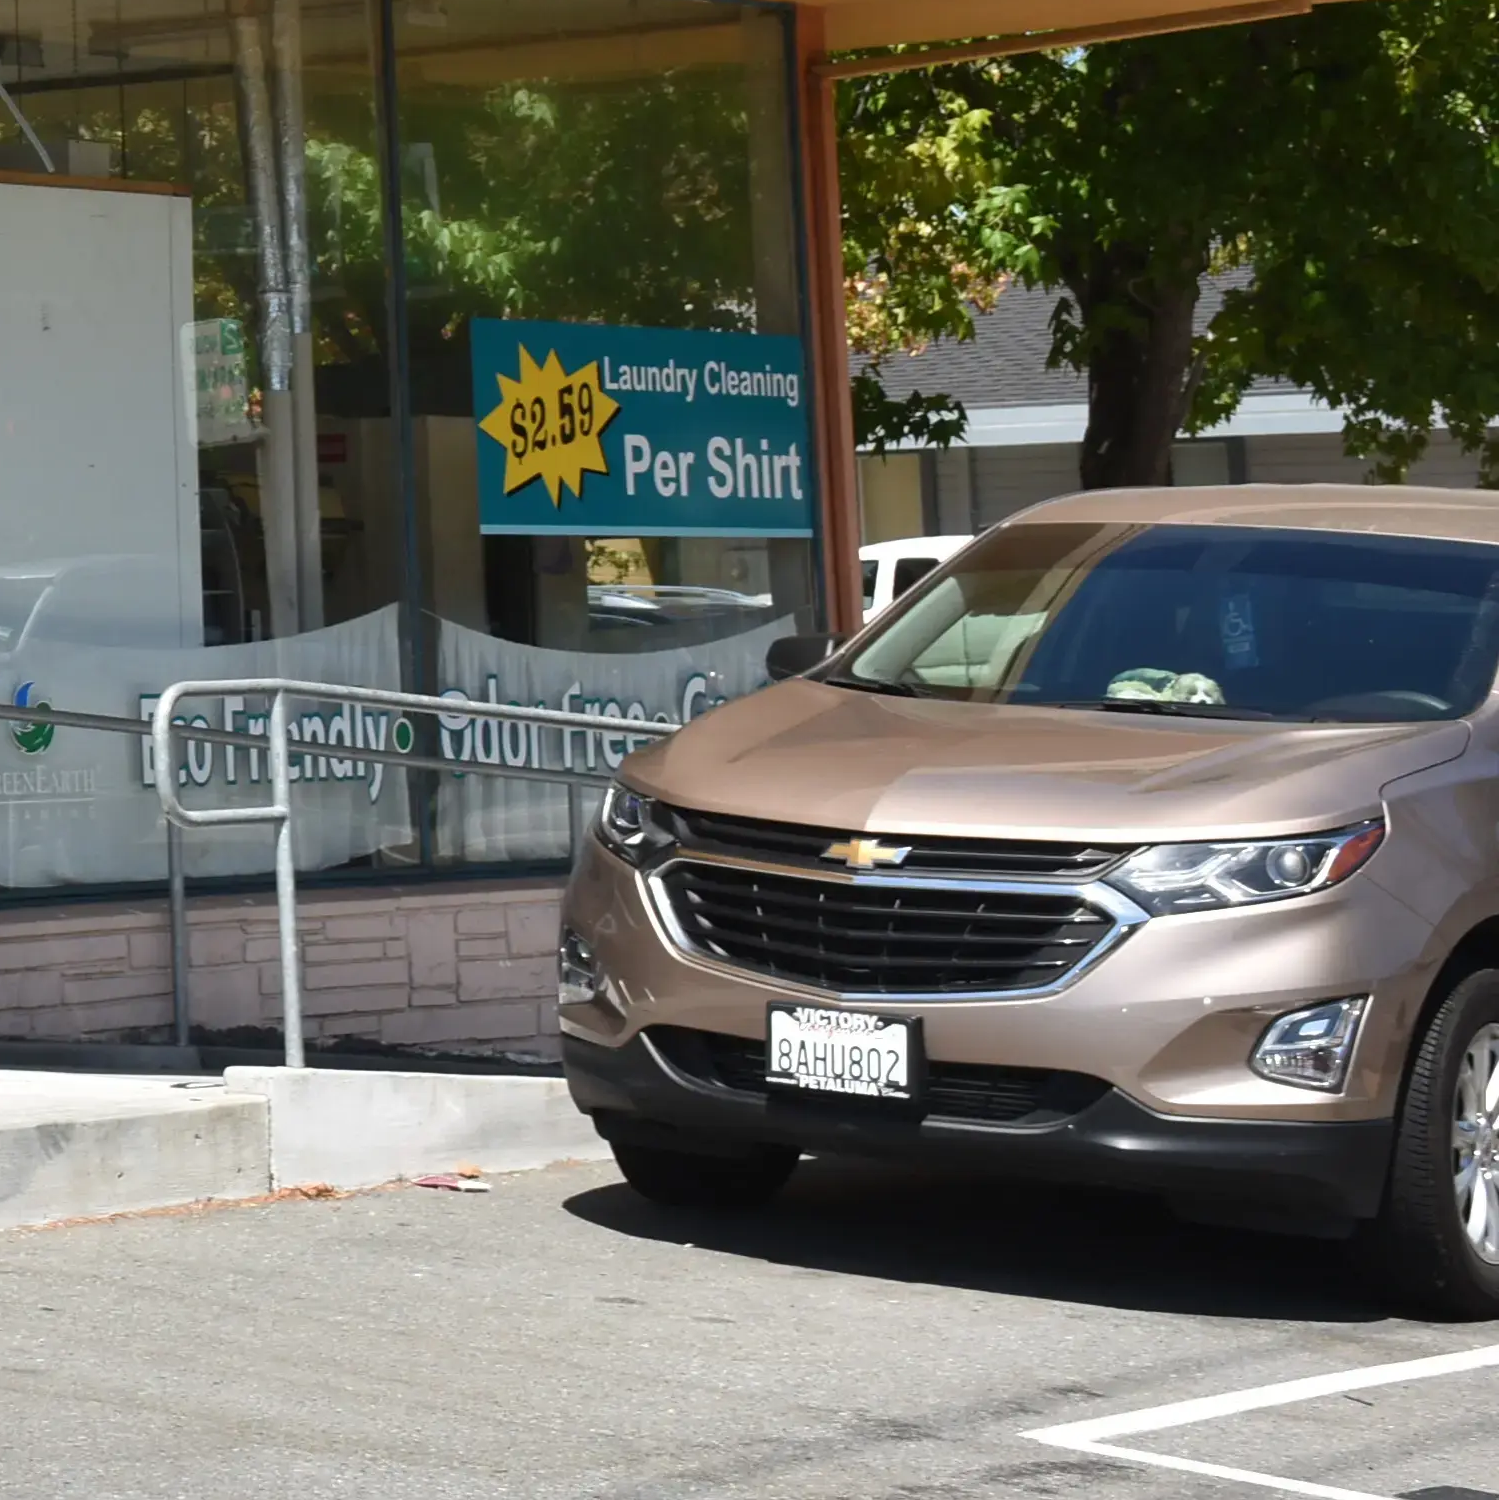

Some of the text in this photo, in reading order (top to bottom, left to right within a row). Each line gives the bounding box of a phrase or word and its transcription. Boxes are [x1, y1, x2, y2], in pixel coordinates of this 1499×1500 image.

[603, 356, 799, 407] Laundry Cleaning
[510, 381, 594, 465] $2.59
[623, 434, 803, 500] Per Shirt
[222, 686, 390, 805] Friendly
[438, 674, 547, 779] Odor
[561, 681, 647, 771] Free
[795, 1007, 879, 1031] VICTORY
[778, 1038, 900, 1085] 8AHU802
[798, 1074, 880, 1097] PETALUMA
